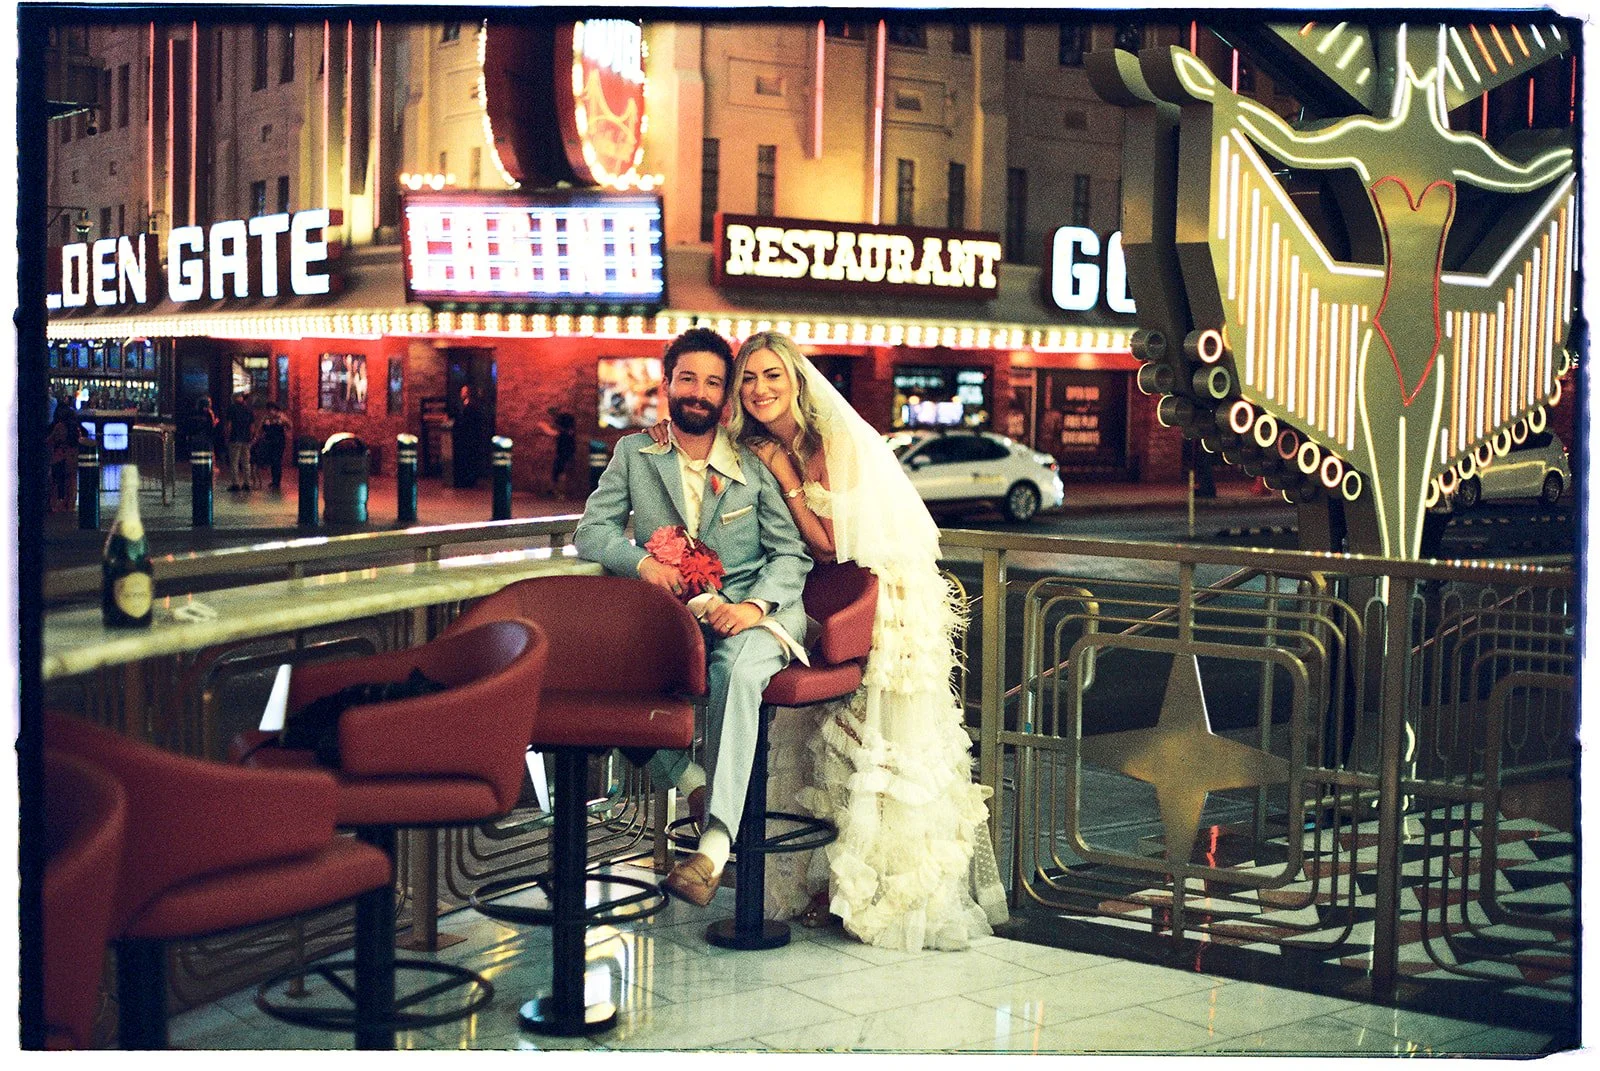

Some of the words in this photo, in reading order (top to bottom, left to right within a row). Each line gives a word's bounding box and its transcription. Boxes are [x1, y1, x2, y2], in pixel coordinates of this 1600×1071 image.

[46, 233, 147, 308] DEN
[168, 208, 330, 302] GATE
[726, 224, 1002, 289] RESTAURANT
